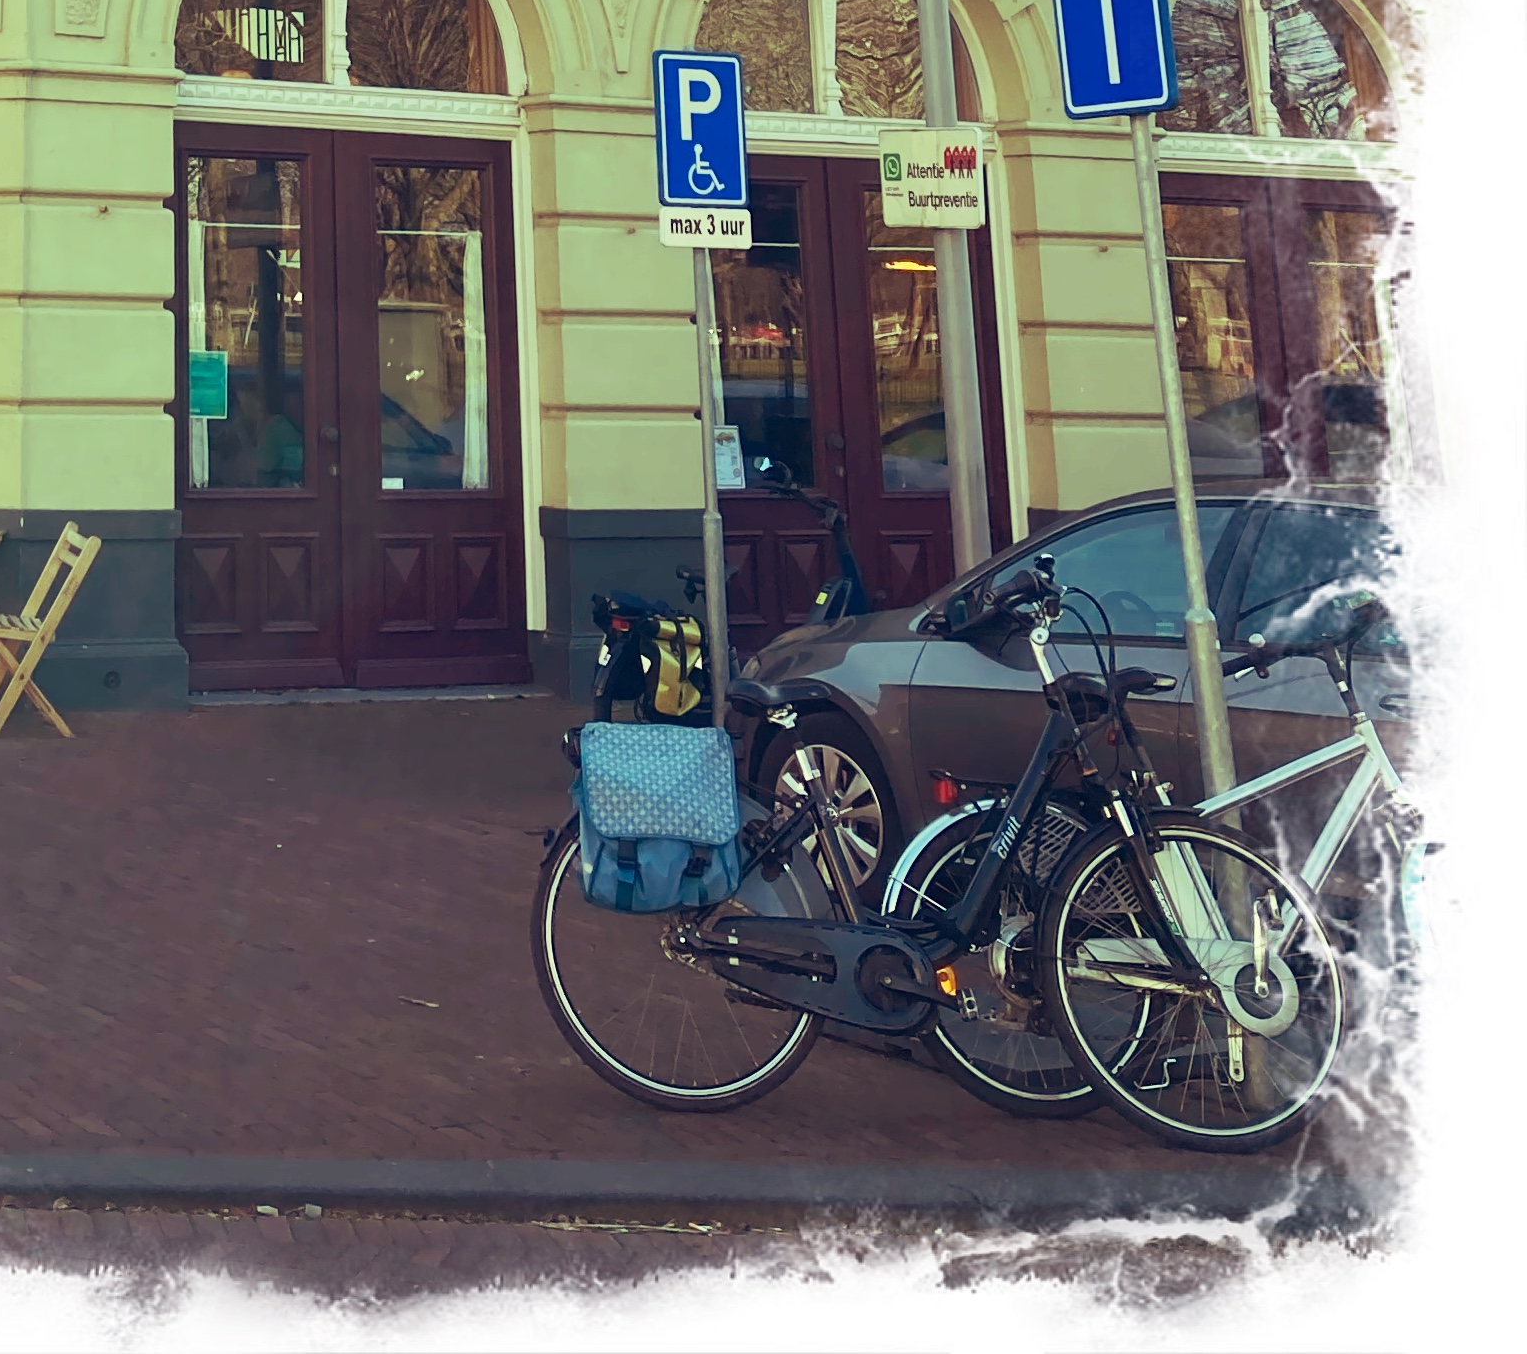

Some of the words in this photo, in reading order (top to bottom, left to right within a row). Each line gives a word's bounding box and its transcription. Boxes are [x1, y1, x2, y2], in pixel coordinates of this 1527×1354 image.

[677, 68, 722, 141] P
[907, 162, 945, 179] Attentie
[908, 190, 978, 211] Buurtpreventie
[670, 218, 702, 235] max
[706, 213, 716, 236] 3
[720, 219, 745, 236] uur
[997, 815, 1022, 860] crivit
